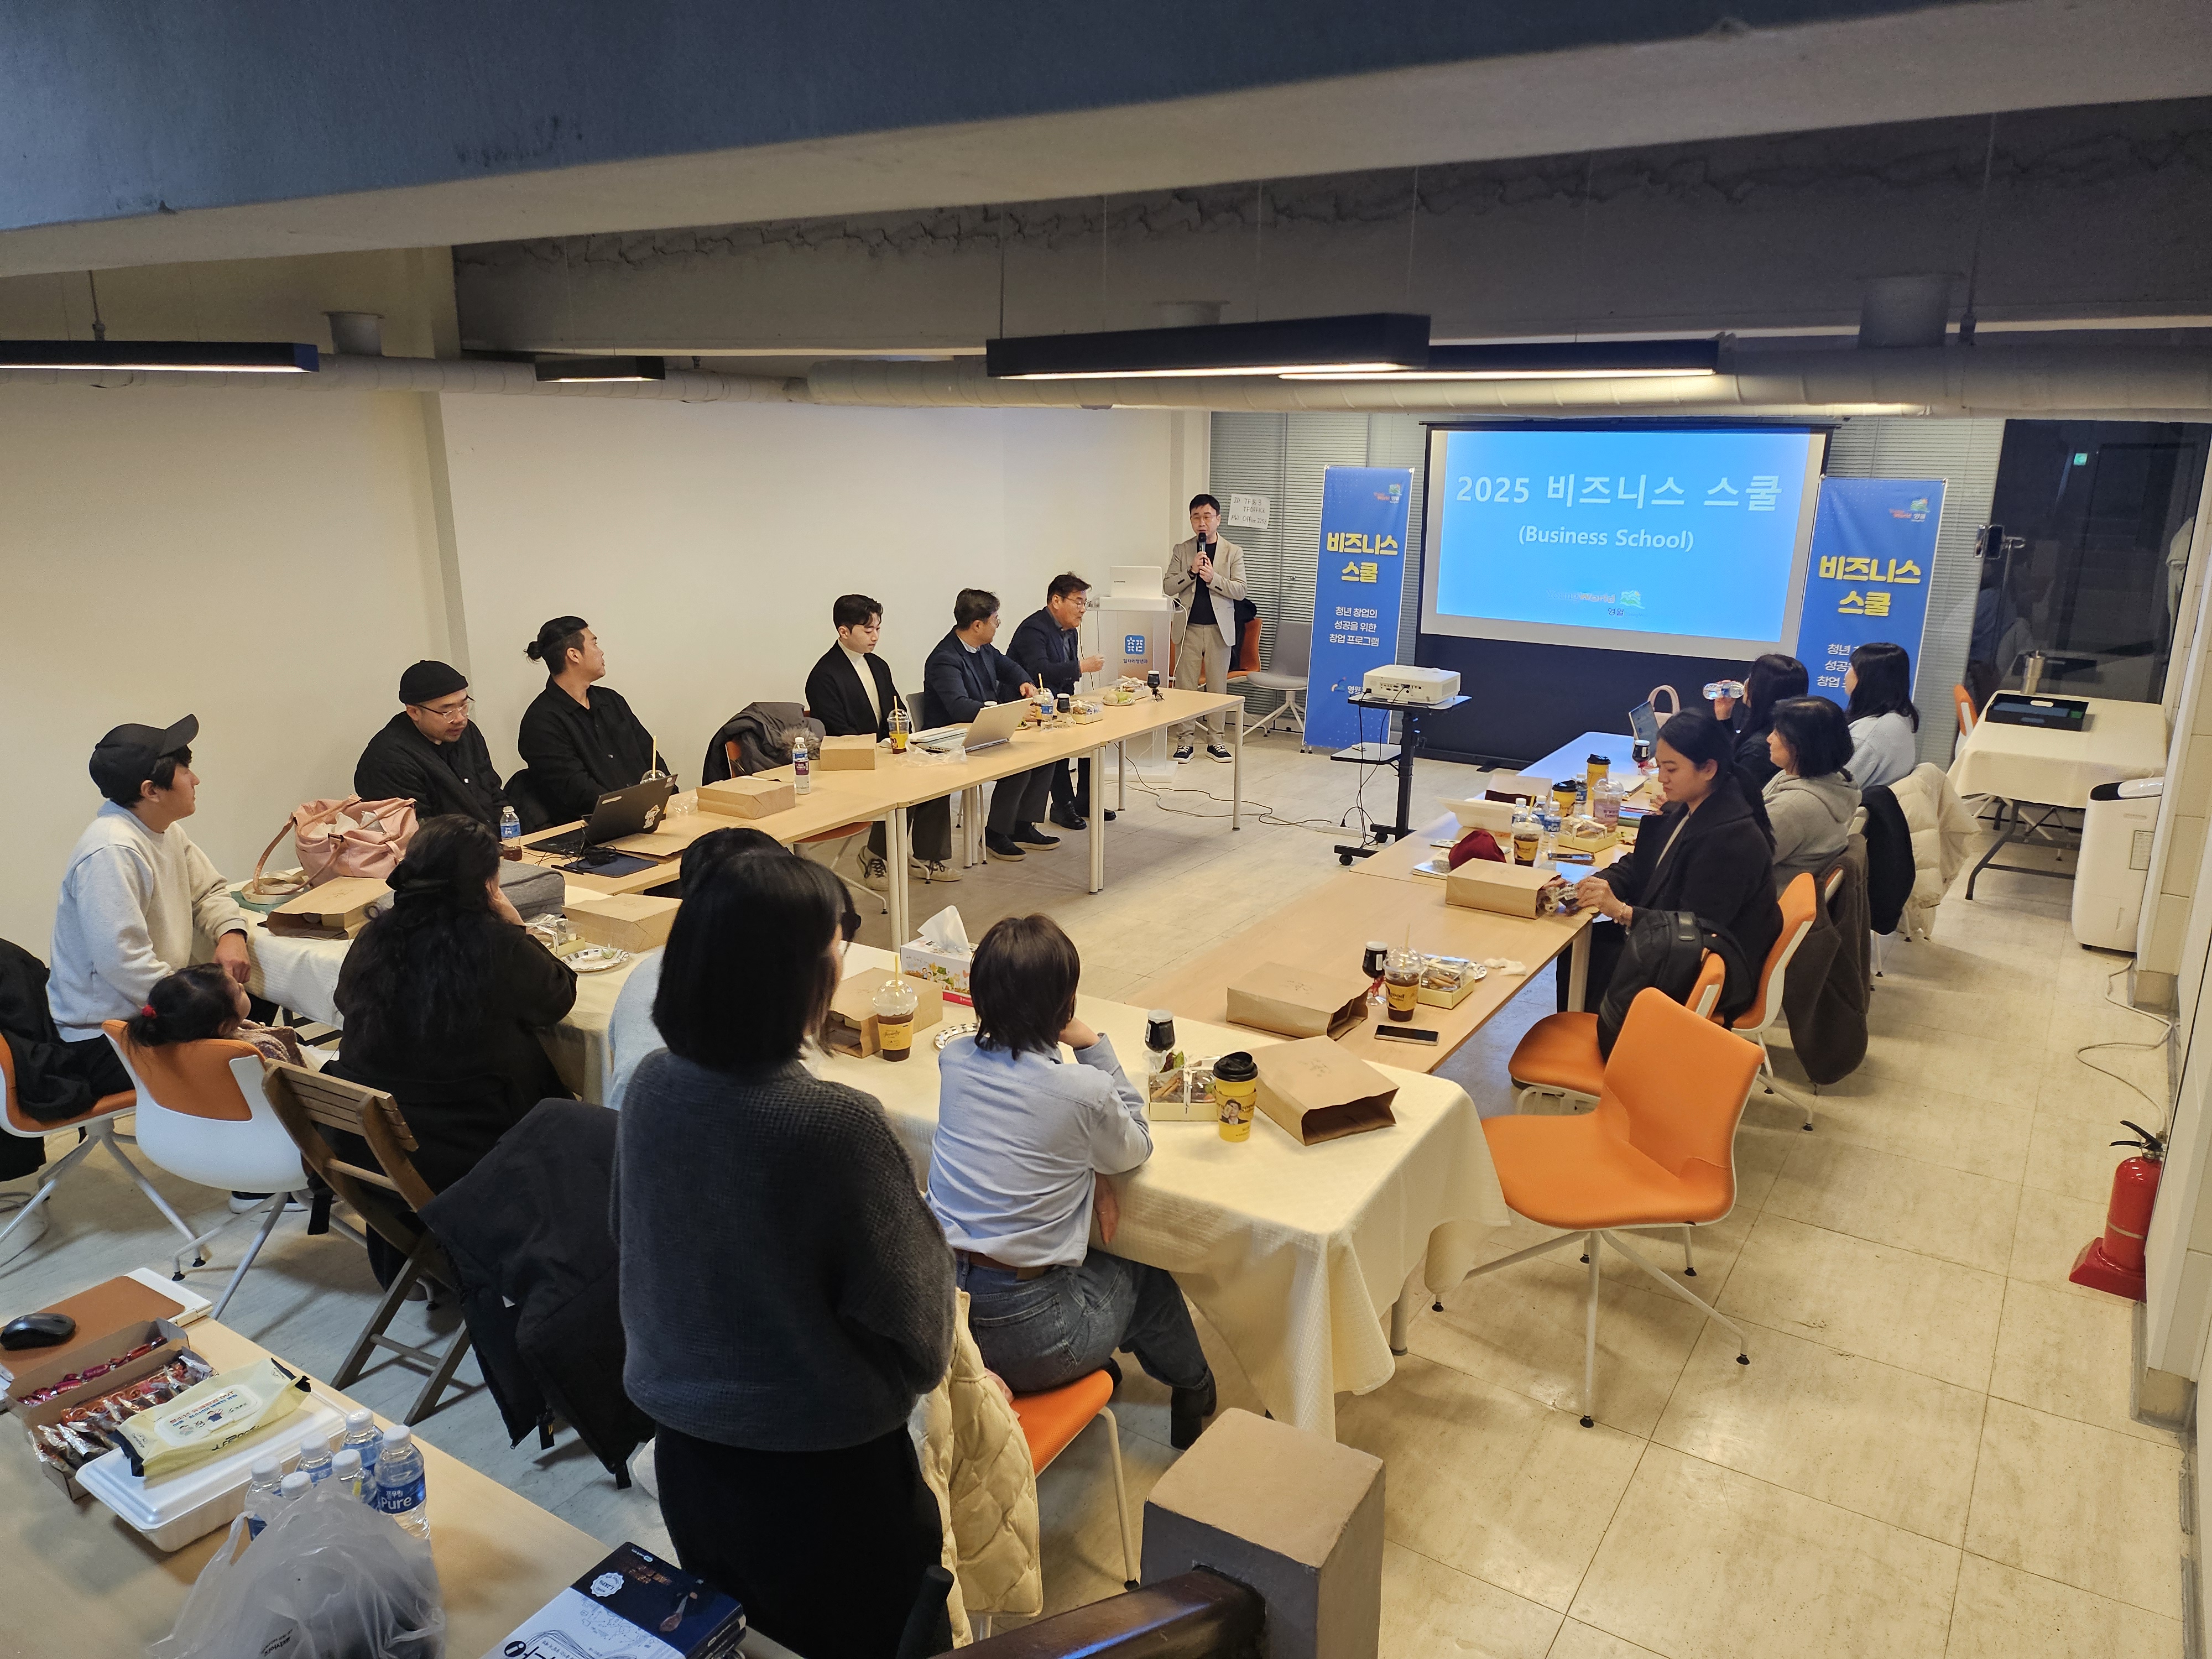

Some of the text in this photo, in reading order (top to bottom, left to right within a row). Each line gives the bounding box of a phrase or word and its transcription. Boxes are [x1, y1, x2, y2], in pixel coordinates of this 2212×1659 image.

[1457, 474, 1782, 512] 2025 비즈니스 스쿨
[1327, 532, 1398, 555] 비즈니스
[1519, 525, 1694, 552] (Business School)
[1341, 561, 1378, 583] 스쿨
[1819, 556, 1921, 583] 비즈니스
[1335, 606, 1378, 618] 청년 창업의
[1838, 591, 1891, 616] 스쿨
[1334, 620, 1376, 633] 성공을 위한
[1329, 633, 1379, 646] 창업 프로그램
[1827, 643, 1851, 655] 청년
[1817, 675, 1840, 687] 창업
[381, 1496, 412, 1510] Pure
